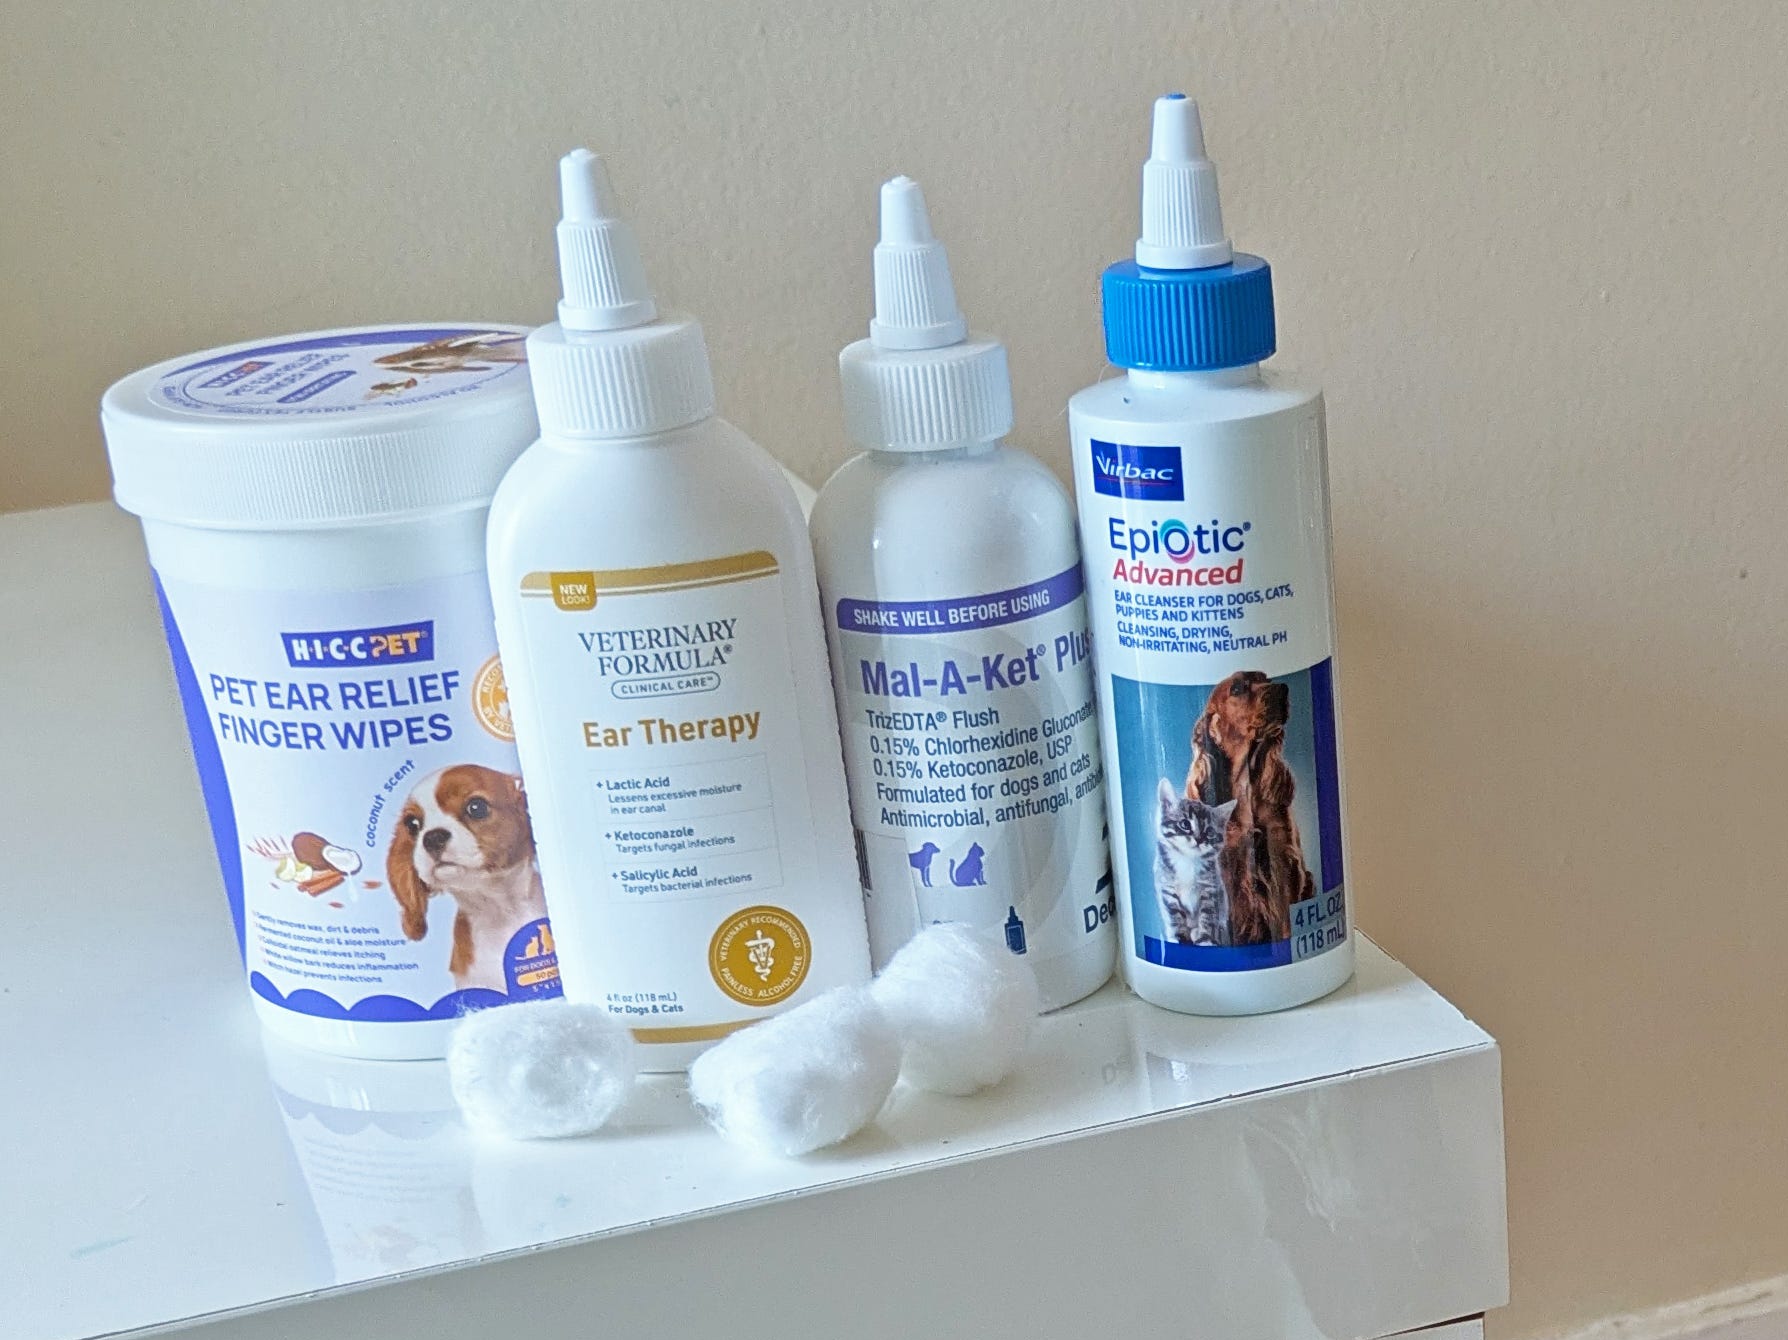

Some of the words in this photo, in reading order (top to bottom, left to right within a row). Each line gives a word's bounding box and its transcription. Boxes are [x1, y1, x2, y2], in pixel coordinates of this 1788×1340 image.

[1095, 451, 1174, 481] Virbac
[1113, 558, 1244, 587] Advanced
[559, 583, 587, 596] NEW
[1114, 589, 1132, 604] EAR
[1134, 593, 1195, 608] CLEANSER
[1199, 595, 1223, 608] FOR
[1227, 590, 1264, 606] DOGS,
[1265, 584, 1294, 601] CATS,
[853, 608, 900, 627] SHAKE
[901, 609, 946, 627] WELL
[948, 601, 1009, 624] BEFORE
[1011, 589, 1051, 614] USING
[1115, 604, 1159, 621] PUPPIES
[1161, 609, 1188, 622] AND
[1191, 607, 1245, 621] KITTENS
[577, 618, 738, 654] VETERINARY
[1117, 621, 1180, 641] CLEANSING,
[1182, 625, 1233, 640] DRYING,
[1118, 634, 1211, 654] NON-IRRITATING,
[1213, 635, 1270, 652] NEUTRAL
[1272, 630, 1288, 645] PH
[209, 673, 258, 707] PET
[264, 681, 334, 712] EAR
[338, 671, 460, 711] RELIEF
[620, 678, 675, 695] CLINICAL
[953, 705, 1000, 729] Flush
[218, 712, 327, 751] FINGER
[330, 713, 454, 750] WIPES
[582, 721, 633, 748] Ear
[637, 711, 761, 746] Therapy
[870, 735, 921, 757] 0.15%
[924, 726, 1038, 756] Chlorhexidine
[873, 758, 923, 780] 0.15%
[927, 748, 1044, 779] Ketoconazole,
[1046, 734, 1073, 760] USP
[605, 778, 641, 791] Lactic
[644, 776, 671, 789] Acid
[876, 781, 967, 804] Formulated
[970, 783, 996, 801] for
[1000, 774, 1039, 798] dogs
[1042, 766, 1068, 787] and
[1070, 752, 1091, 777] cats
[366, 793, 387, 848] coconut
[383, 759, 416, 793] scent
[608, 793, 649, 804] Lessens
[650, 789, 698, 801] excessive
[699, 783, 743, 796] moisture
[610, 805, 620, 815] in
[621, 805, 637, 814] ear
[639, 803, 667, 814] canal
[880, 807, 991, 828] Antimicrobial,
[995, 788, 1073, 823] antifungal,
[614, 826, 695, 842] Ketoconazole
[616, 842, 652, 856] Targets
[654, 840, 686, 855] fungal
[687, 835, 736, 849] infections
[620, 868, 670, 883] Salicylic
[672, 866, 698, 879] Acid
[622, 883, 659, 896] Targets
[660, 878, 703, 893] bacterial
[705, 873, 753, 887] infections
[1294, 908, 1305, 928] 4
[1308, 902, 1327, 926] FL
[351, 925, 380, 935] debris
[364, 937, 406, 947] moisture
[319, 948, 353, 958] relieves
[353, 950, 386, 961] itching
[1296, 929, 1325, 959] (118
[322, 960, 356, 971] reduces
[357, 961, 419, 971] inflammation
[721, 966, 755, 997] PAINLESS
[757, 977, 794, 998] ALCOHOL
[789, 955, 803, 977] FREE
[339, 974, 383, 984] infections
[608, 1004, 624, 1014] For
[625, 1004, 650, 1016] Dogs
[651, 1004, 660, 1014] &
[661, 1004, 684, 1013] Cats
